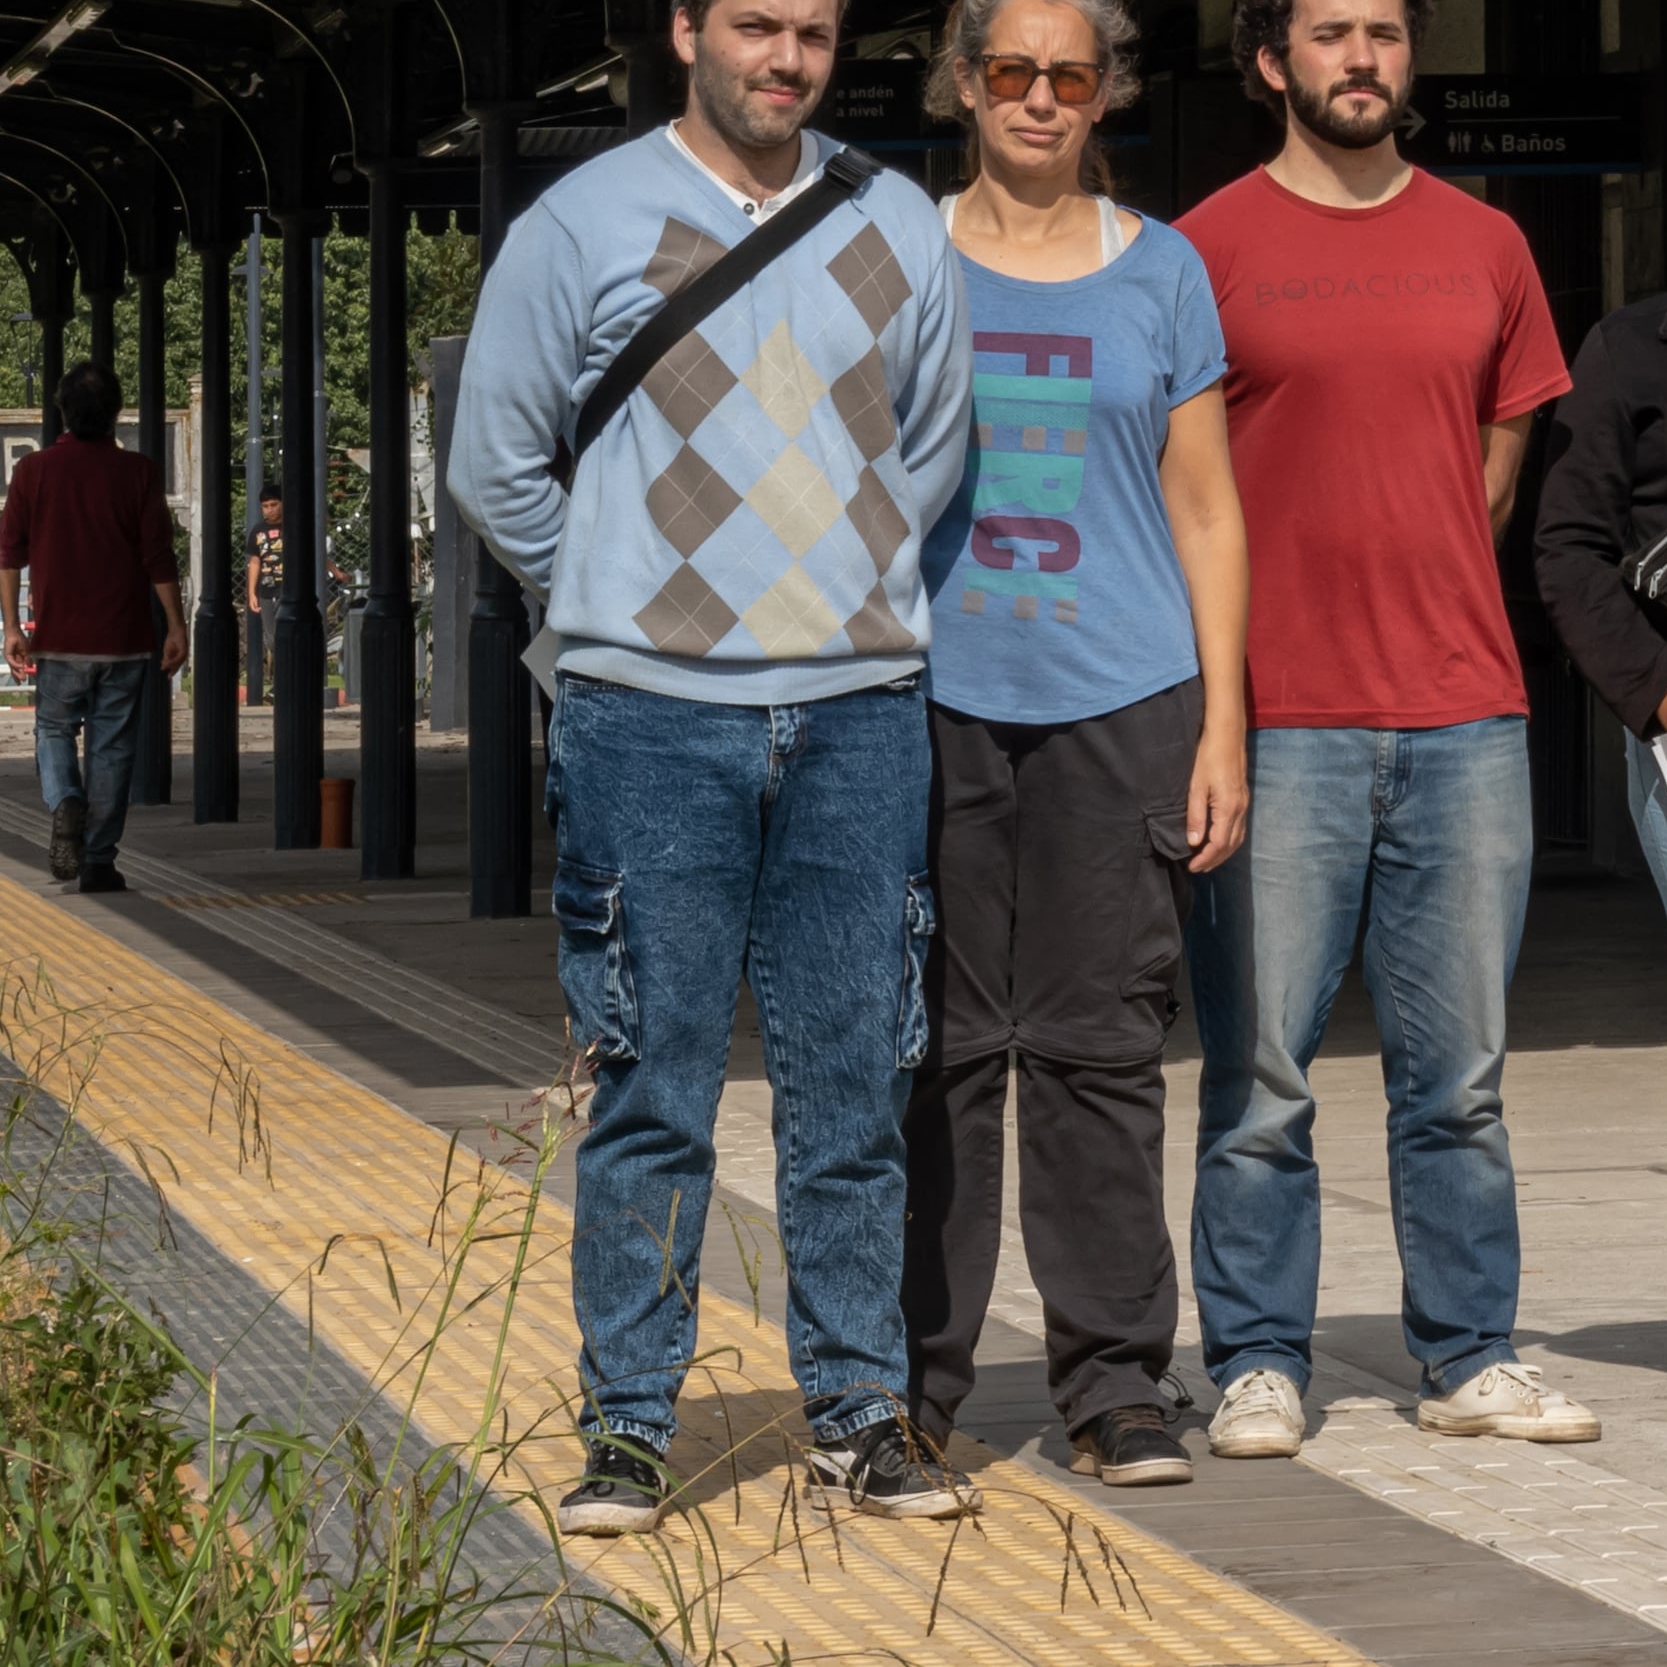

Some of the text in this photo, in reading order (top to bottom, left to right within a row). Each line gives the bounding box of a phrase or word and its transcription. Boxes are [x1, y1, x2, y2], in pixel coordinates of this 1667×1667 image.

[848, 82, 895, 100] andén
[1444, 89, 1511, 110] Salida
[848, 103, 886, 118] nivel
[1501, 132, 1567, 153] Baños
[1255, 272, 1478, 306] BODACIOUS
[960, 330, 1093, 623] FIERCE
